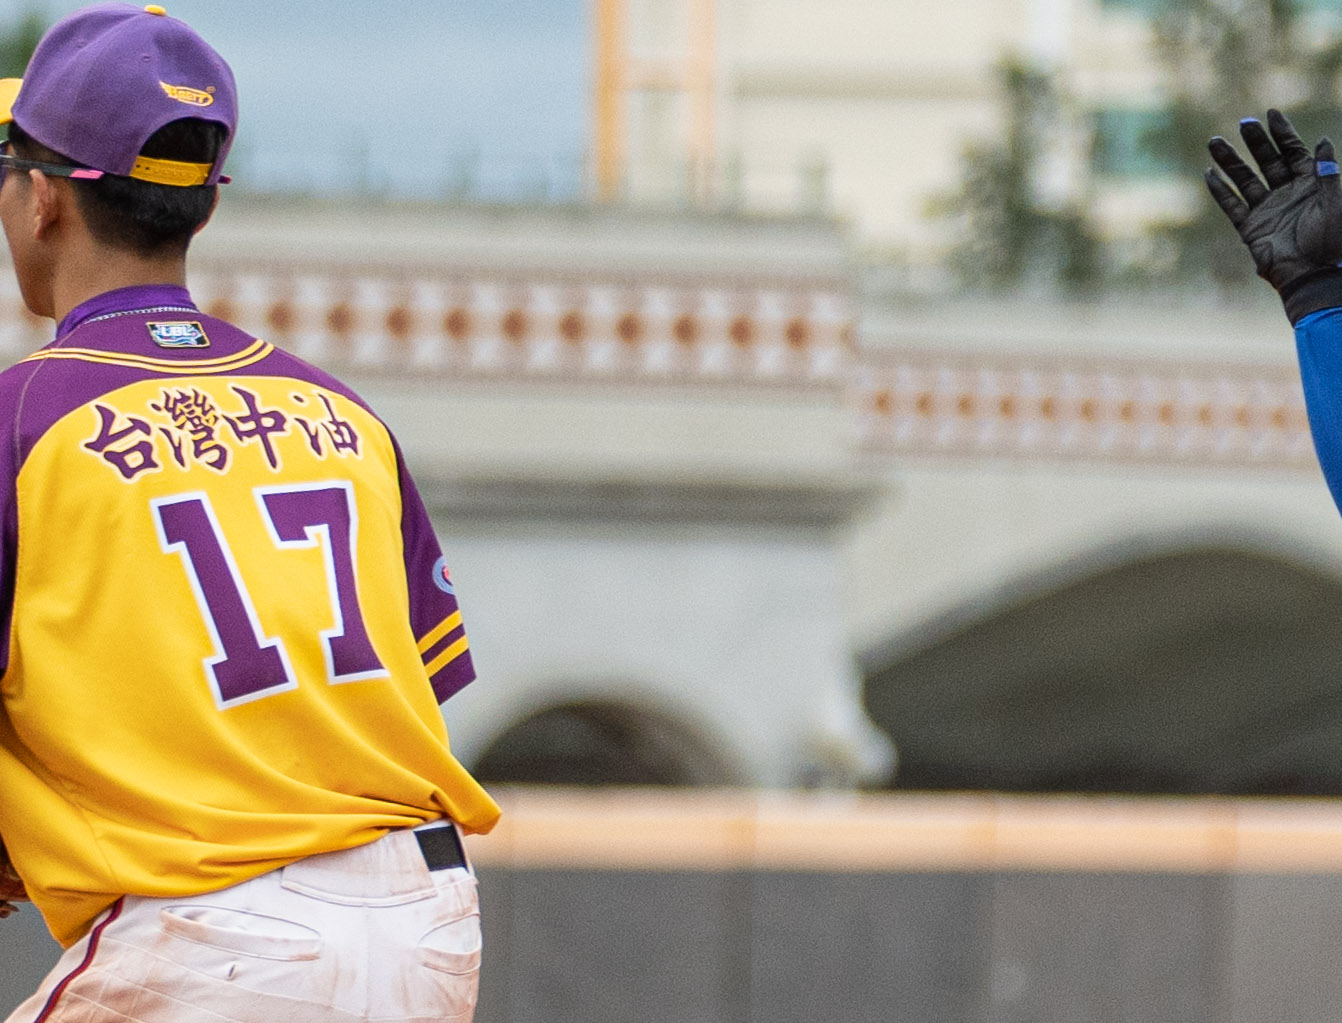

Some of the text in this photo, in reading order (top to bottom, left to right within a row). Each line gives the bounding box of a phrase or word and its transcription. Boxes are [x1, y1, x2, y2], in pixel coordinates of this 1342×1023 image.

[83, 384, 360, 480] 台灣中油
[150, 480, 390, 711] 17
